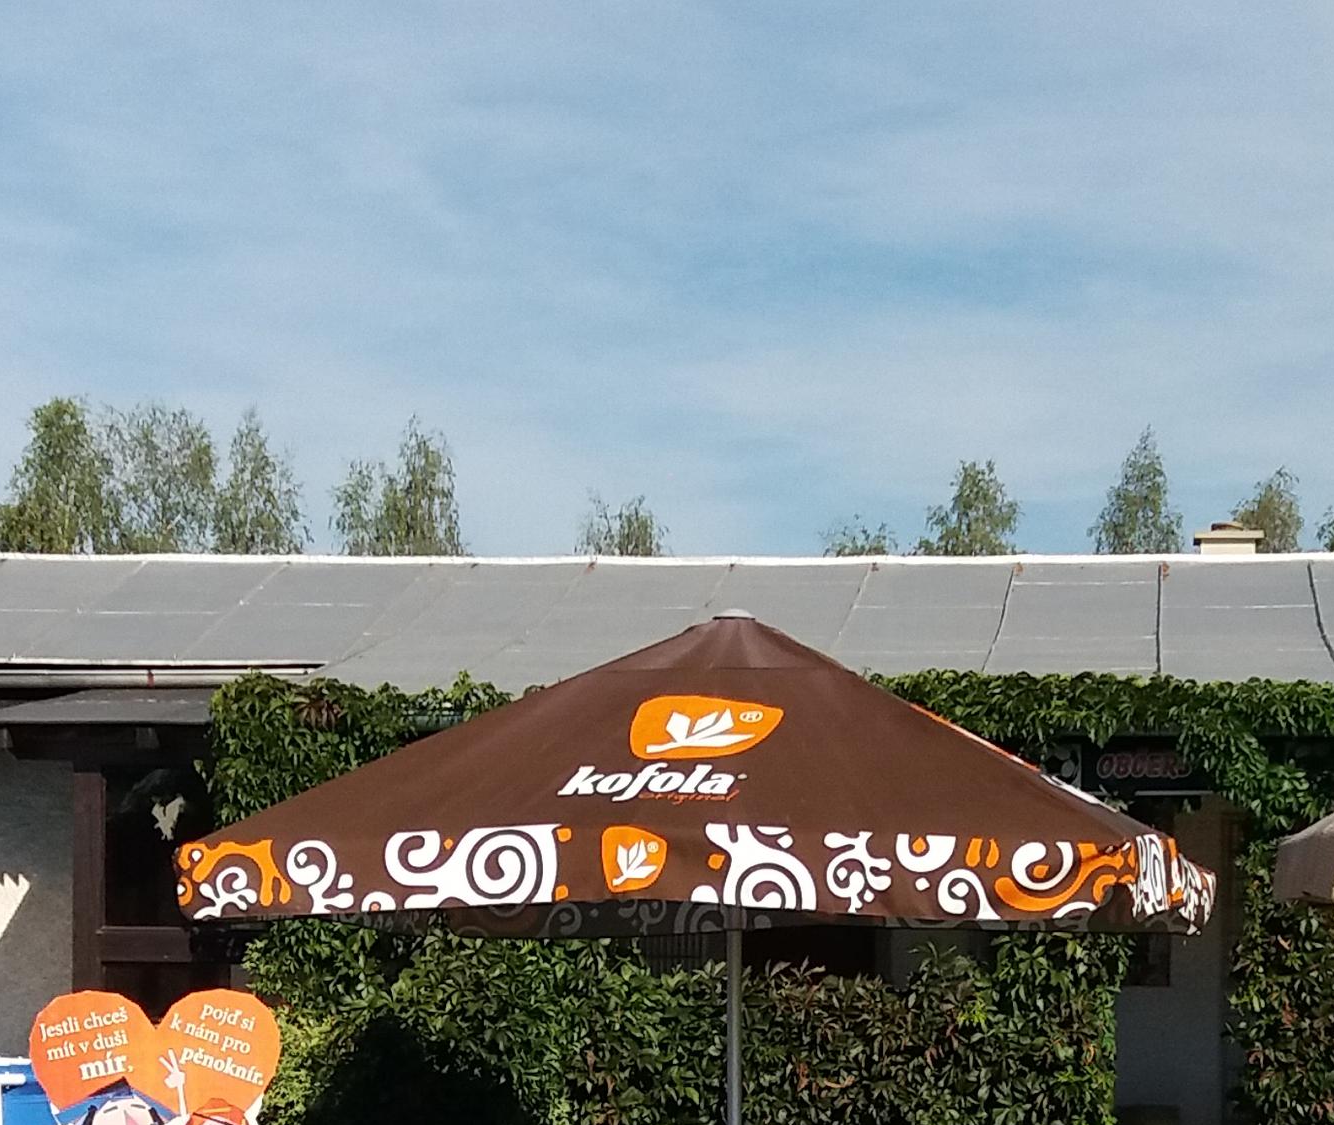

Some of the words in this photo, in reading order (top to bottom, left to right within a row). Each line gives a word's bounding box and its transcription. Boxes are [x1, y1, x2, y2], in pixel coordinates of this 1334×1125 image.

[557, 762, 736, 802] kofola
[638, 789, 740, 806] original
[39, 1016, 80, 1043] Jestli
[83, 1006, 128, 1030] chceš
[170, 1012, 183, 1032] k
[183, 1022, 220, 1045] nám
[220, 1035, 252, 1055] pro
[199, 1003, 243, 1026] pojď
[240, 1016, 256, 1032] si
[47, 1040, 76, 1061] mít
[78, 1040, 90, 1054] v
[92, 1029, 129, 1051] duši
[79, 1051, 134, 1081] mír,
[179, 1046, 265, 1087] pěnoknír.
